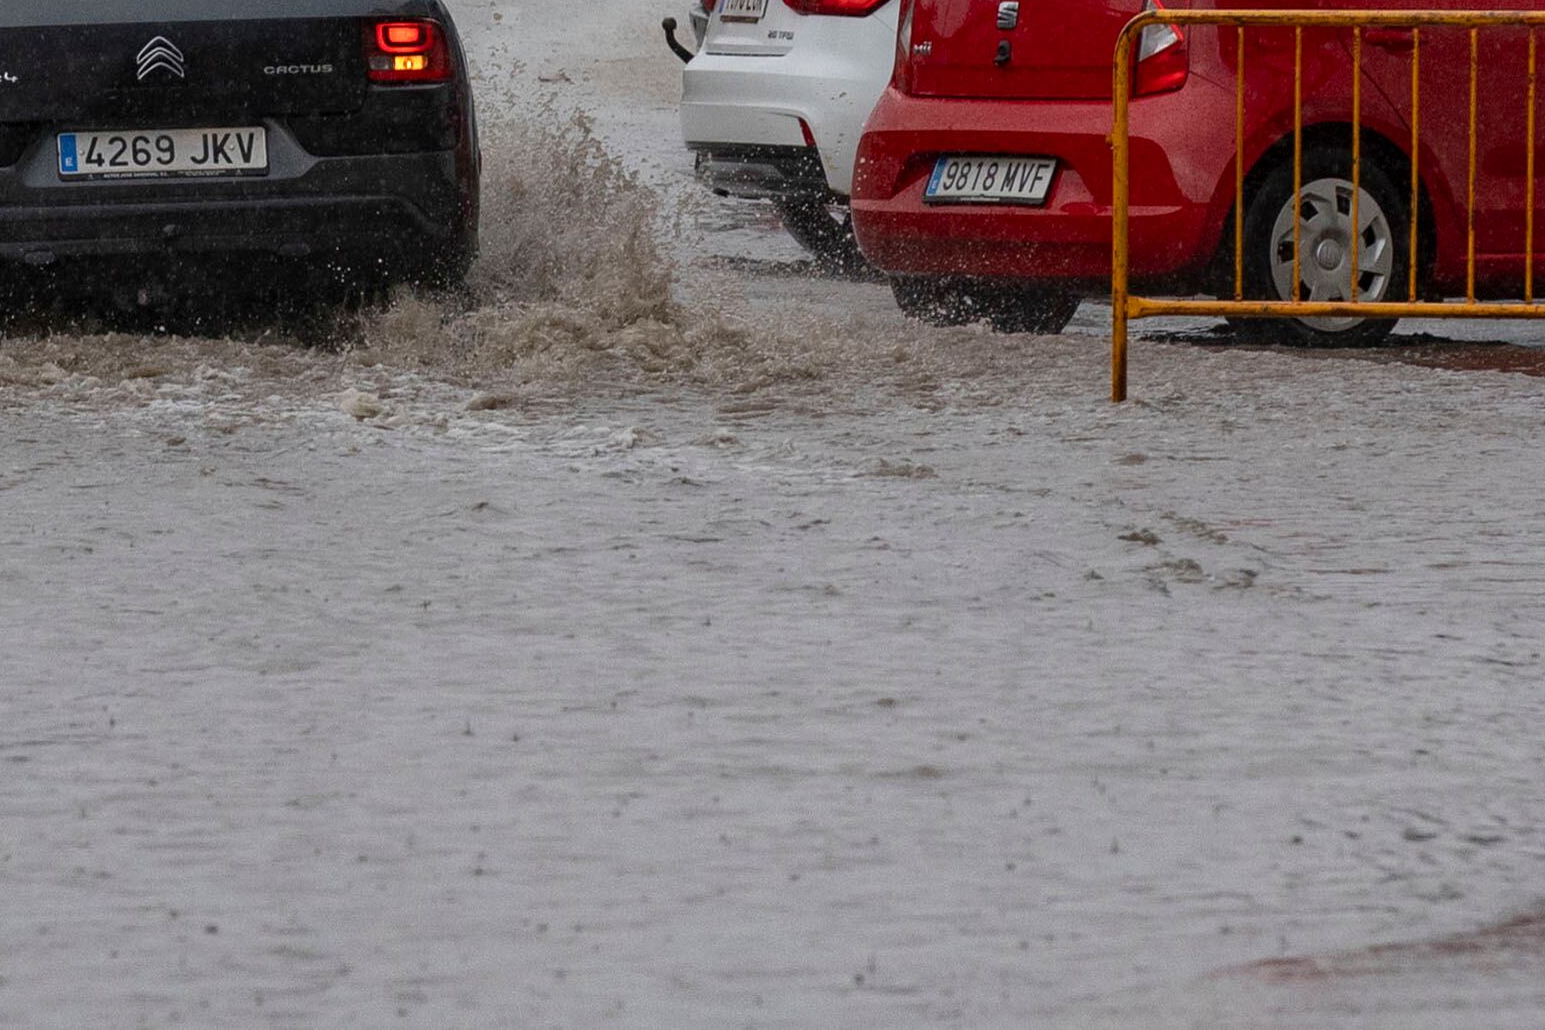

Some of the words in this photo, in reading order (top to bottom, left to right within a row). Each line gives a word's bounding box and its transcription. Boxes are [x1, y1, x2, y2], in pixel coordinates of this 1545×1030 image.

[263, 64, 333, 75] CACTUS
[85, 135, 175, 168] 4269
[190, 132, 255, 165] JKV
[942, 161, 999, 191] 9818
[999, 161, 1050, 194] MVF
